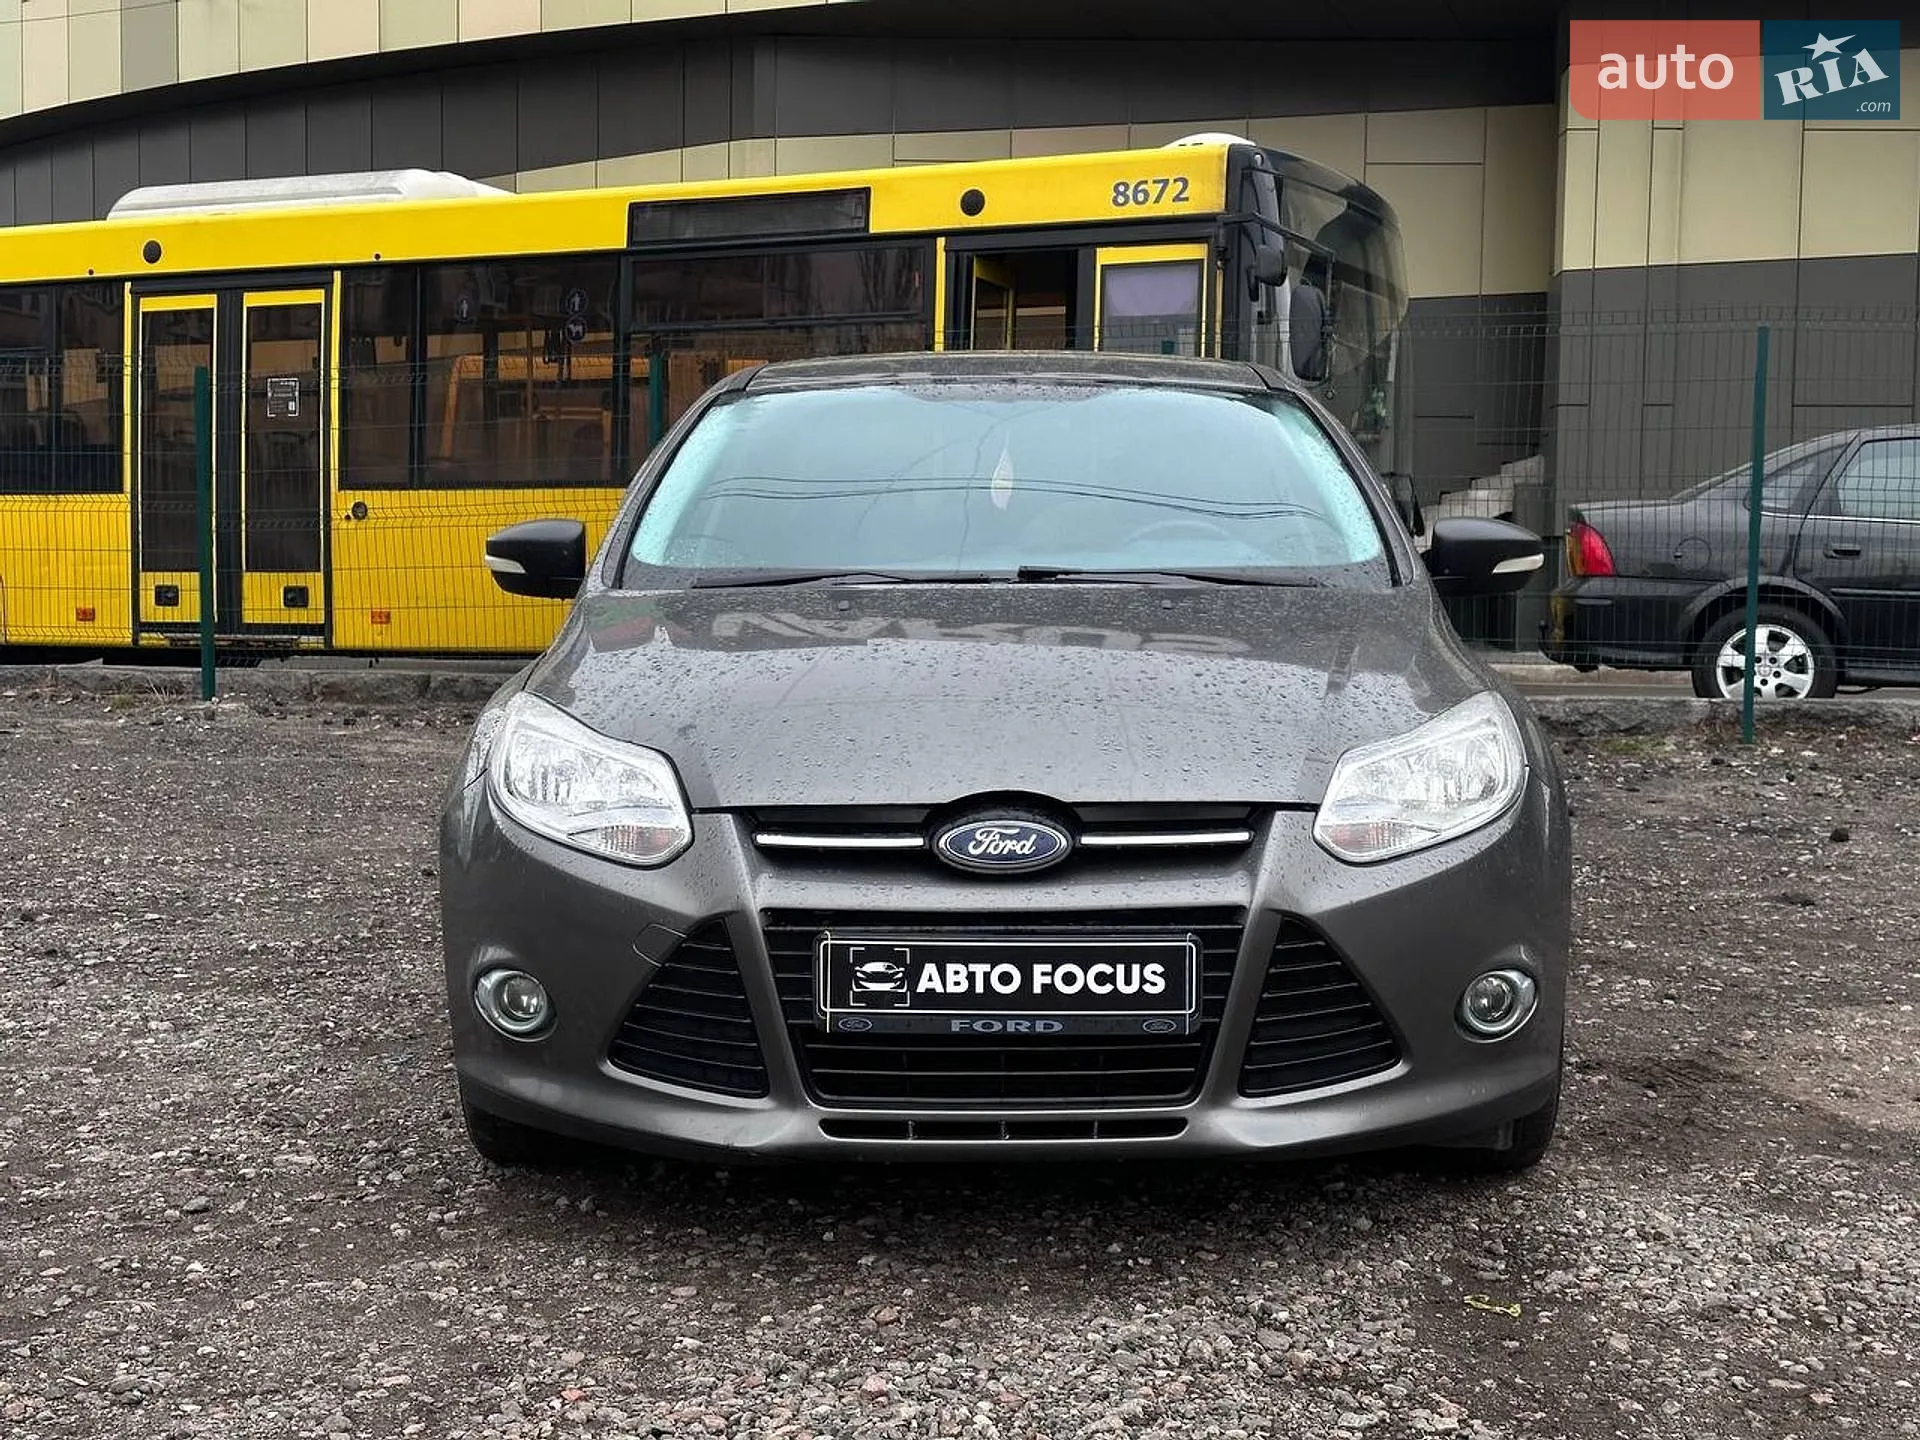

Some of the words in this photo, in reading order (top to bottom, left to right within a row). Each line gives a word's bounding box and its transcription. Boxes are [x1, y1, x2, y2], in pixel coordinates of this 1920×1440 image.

[1111, 176, 1190, 207] 8672
[967, 827, 1038, 855] Ford
[916, 962, 1022, 995] АВТО
[1032, 962, 1166, 995] FOCUS
[951, 1019, 1064, 1033] FORD
